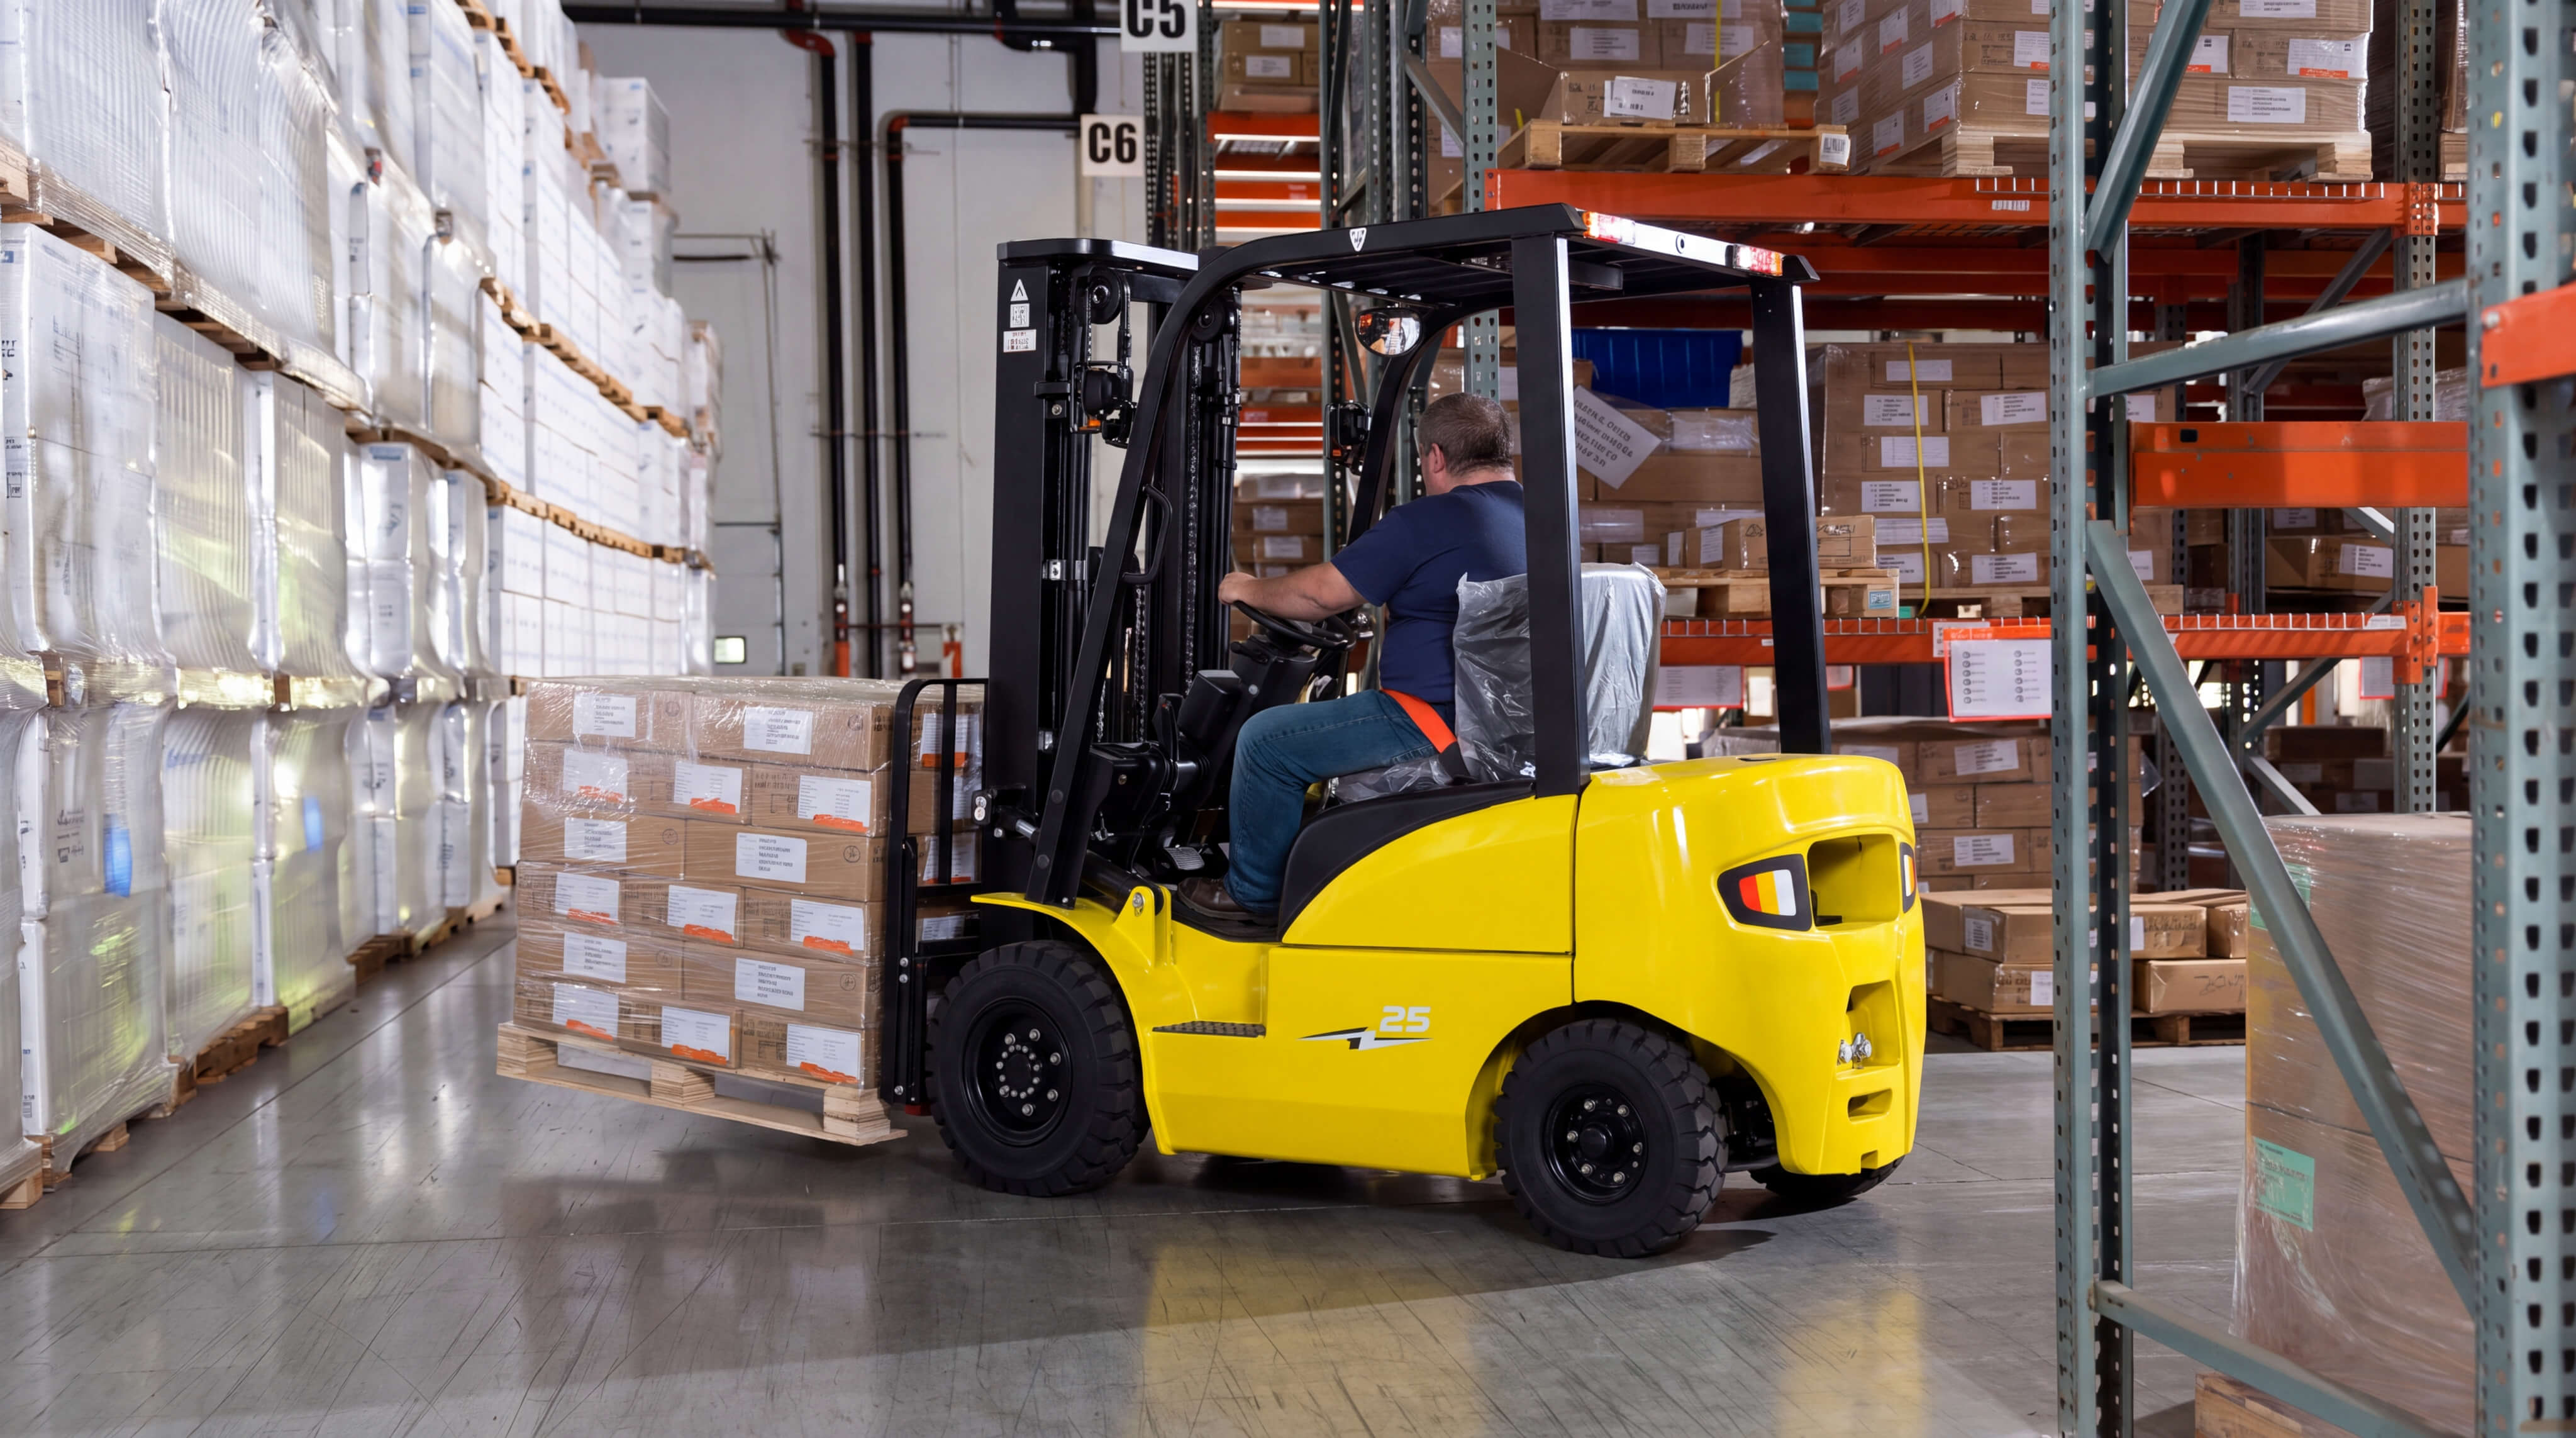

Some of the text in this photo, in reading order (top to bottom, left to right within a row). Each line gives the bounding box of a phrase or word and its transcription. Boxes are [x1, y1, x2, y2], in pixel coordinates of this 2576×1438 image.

[1126, 0, 1185, 38] C5
[1089, 123, 1137, 164] C6
[1379, 1006, 1431, 1032] 25
